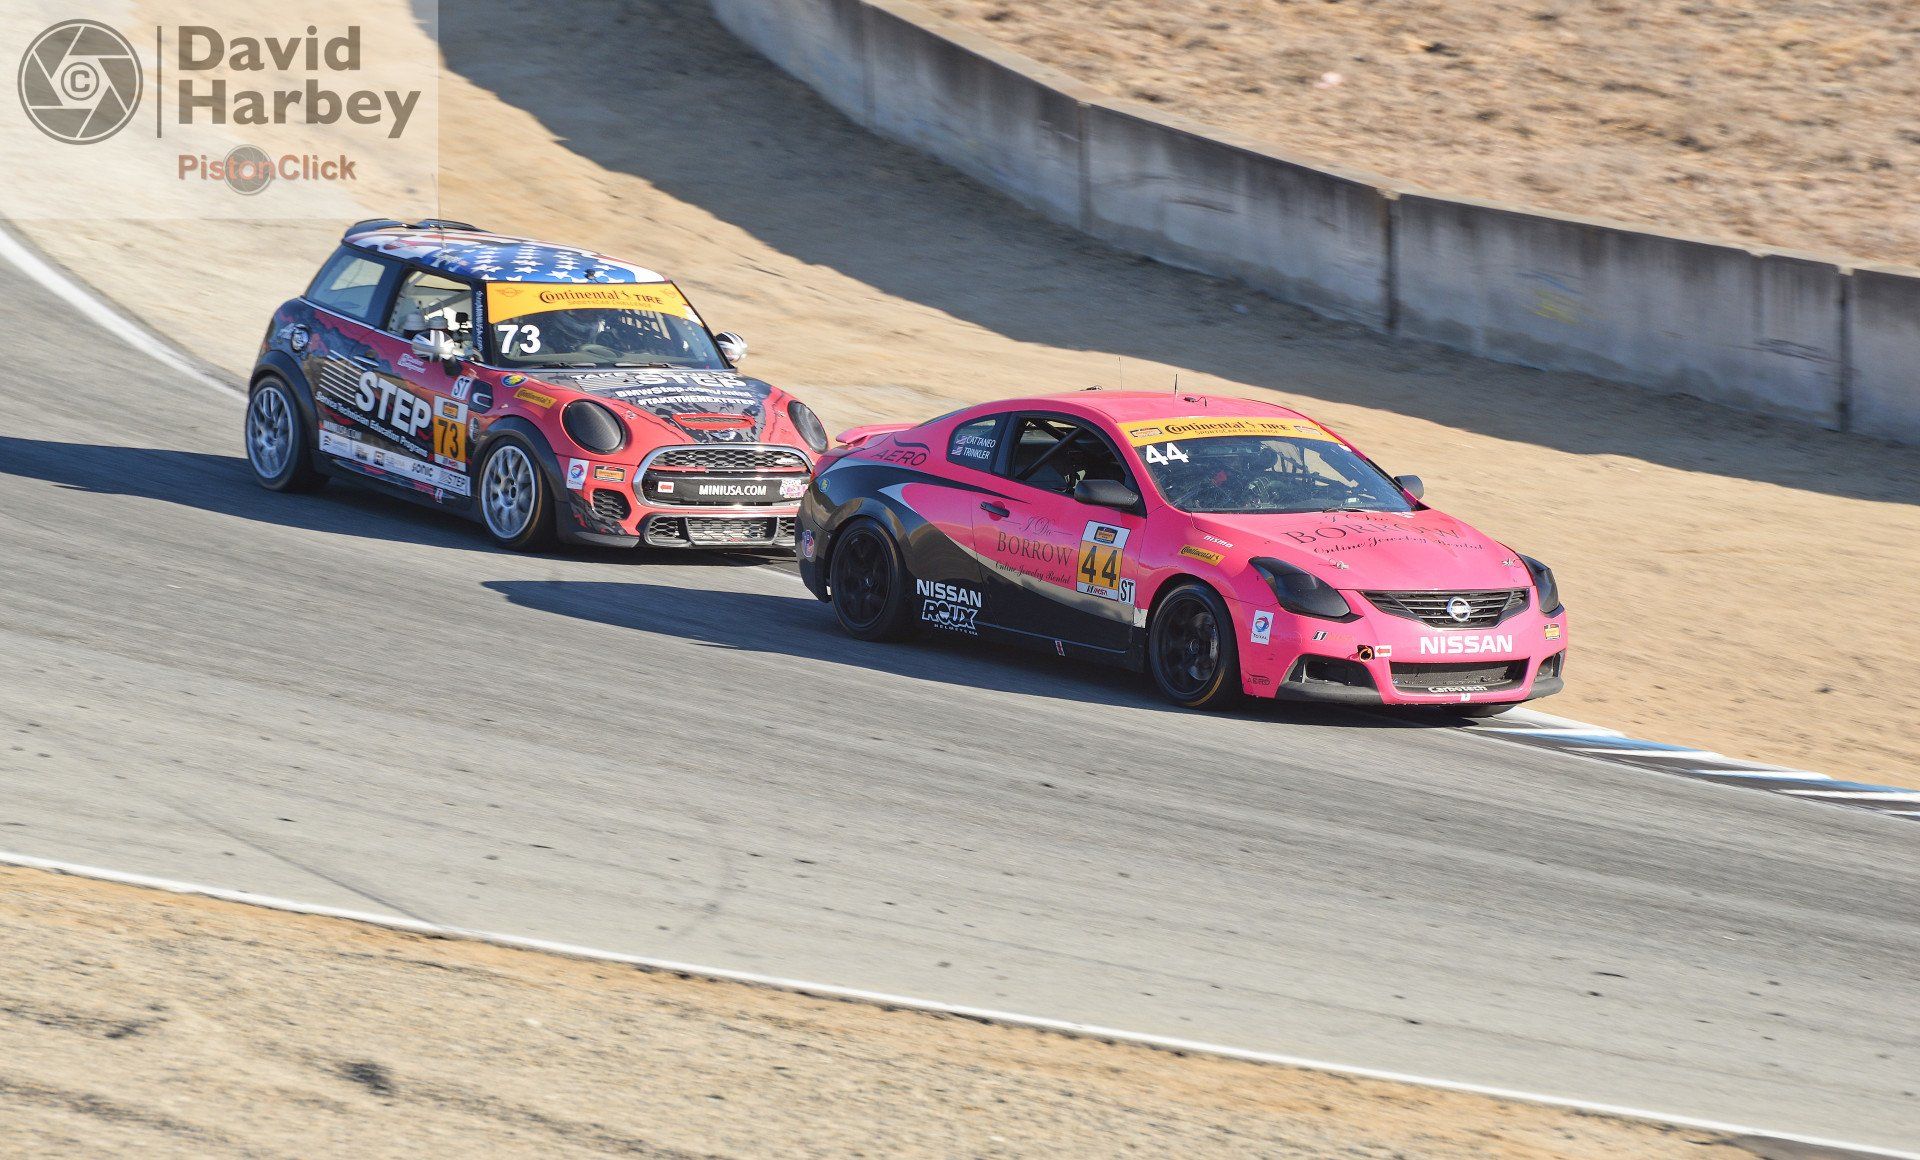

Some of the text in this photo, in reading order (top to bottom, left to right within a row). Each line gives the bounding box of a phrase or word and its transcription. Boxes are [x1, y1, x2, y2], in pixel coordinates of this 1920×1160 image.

[540, 289, 664, 305] Continental TIRE
[497, 323, 541, 354] 73
[452, 377, 471, 399] ST
[634, 371, 747, 389] STEP
[355, 371, 432, 437] STEP
[337, 402, 369, 426] Technician
[369, 420, 400, 442] Education
[1164, 421, 1246, 435] Continental
[1260, 423, 1291, 431] TIRE
[438, 419, 459, 458] 73
[966, 435, 997, 448] CATTANEO
[871, 449, 927, 466] AERO
[963, 446, 991, 460] TRINKLER
[1146, 441, 1189, 466] 44
[699, 484, 767, 496] MINIUSA.COM
[1203, 535, 1234, 548] nismo
[1281, 522, 1460, 545] BORROW
[997, 531, 1073, 567] BORROW
[1181, 546, 1215, 560] Continental
[1016, 565, 1044, 582] Jewelry
[1045, 571, 1071, 585] Rental
[1081, 545, 1118, 587] 44
[916, 578, 982, 608] NISSAN
[1120, 579, 1135, 603] ST
[921, 599, 979, 630] ROUX
[1420, 634, 1513, 655] NISSAN
[1427, 685, 1488, 693] Carbotech
